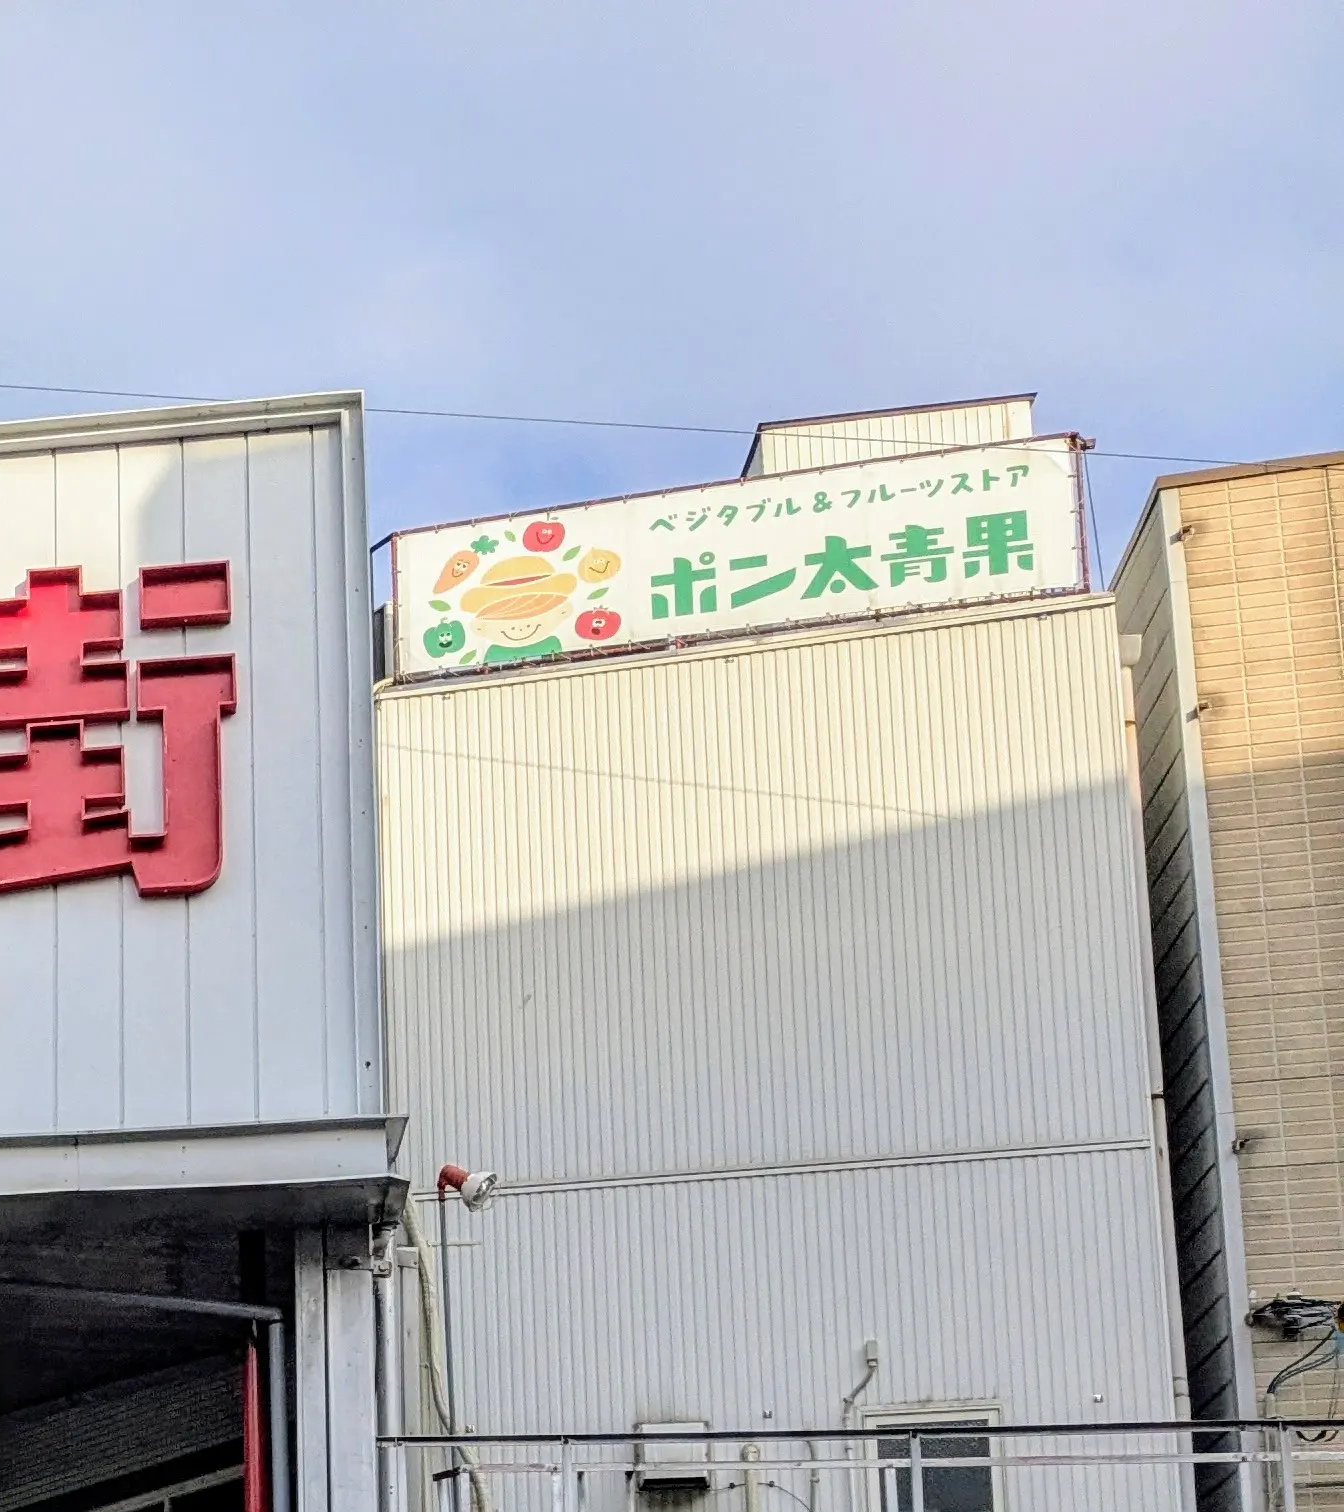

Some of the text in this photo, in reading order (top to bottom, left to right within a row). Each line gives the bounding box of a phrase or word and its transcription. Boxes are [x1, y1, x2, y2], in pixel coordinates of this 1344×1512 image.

[650, 509, 1035, 621] ポン太青果
